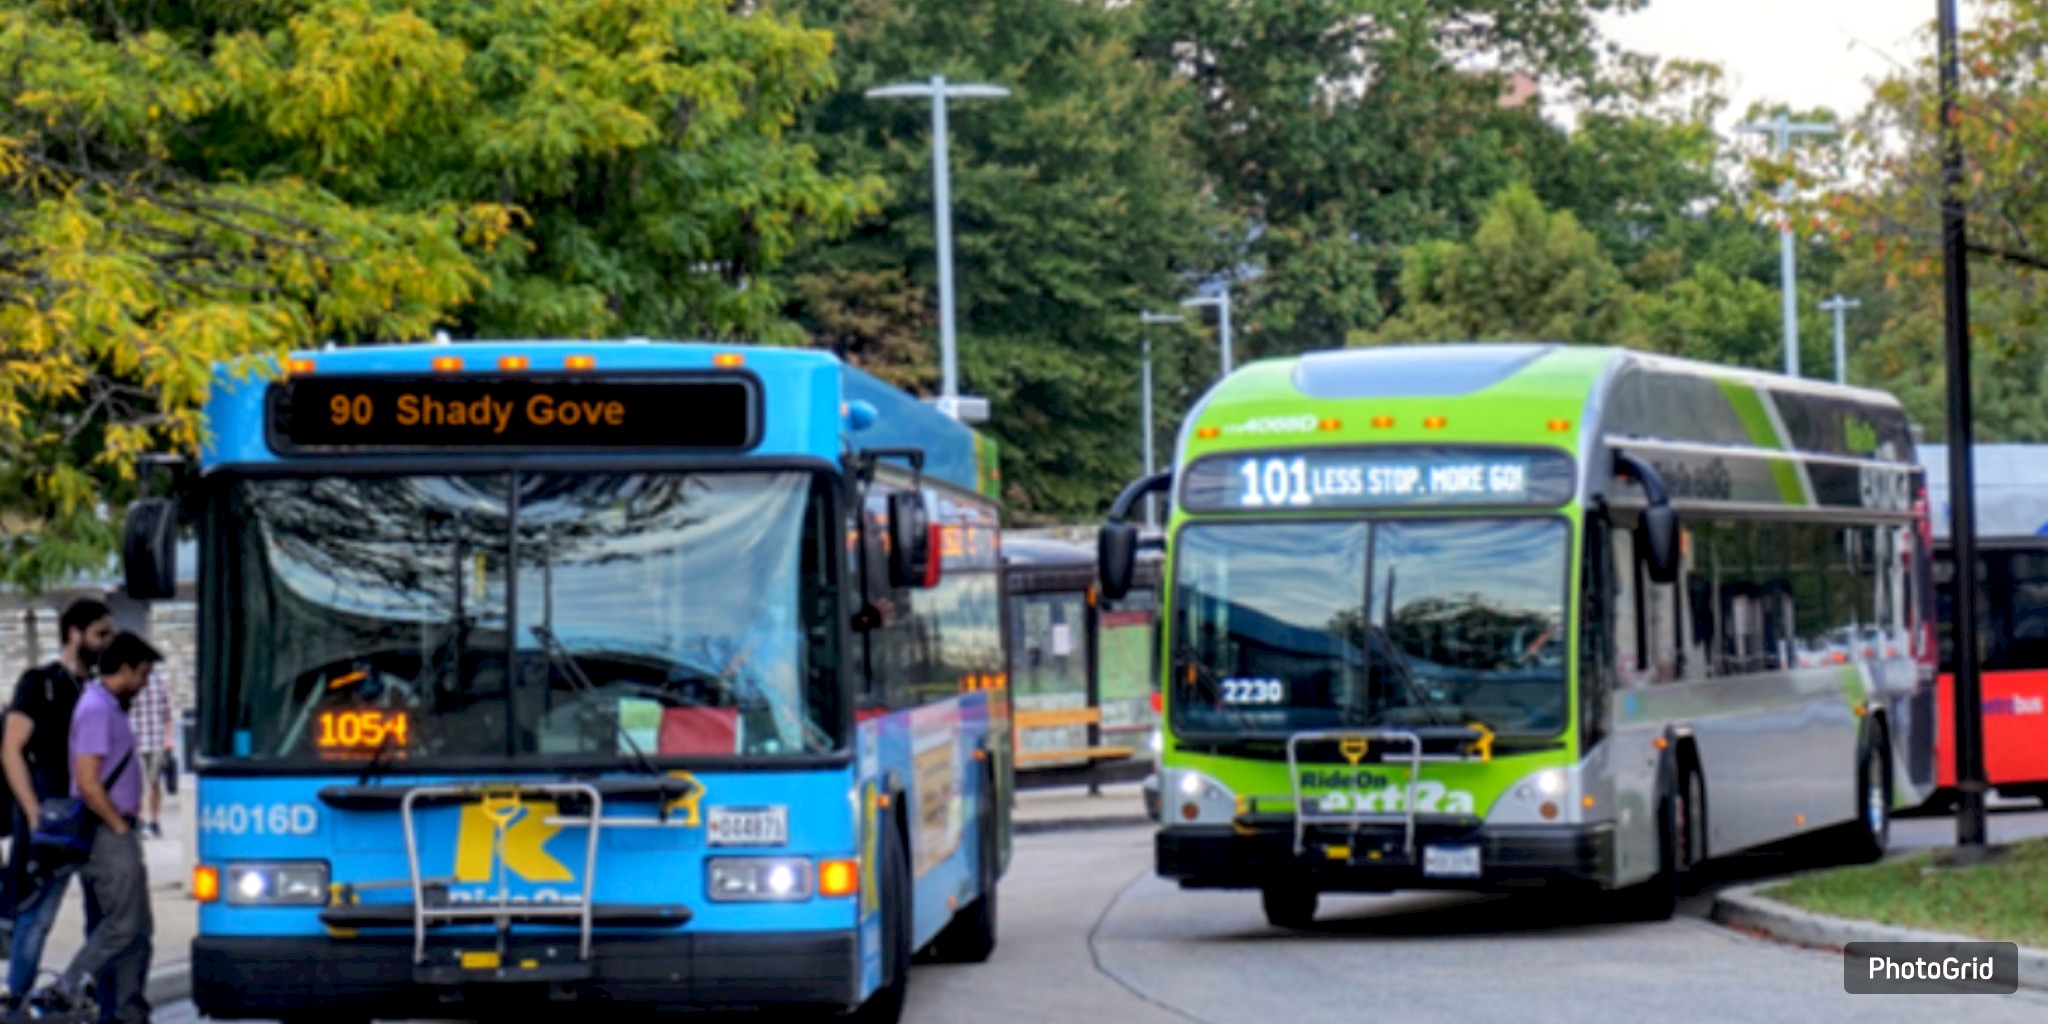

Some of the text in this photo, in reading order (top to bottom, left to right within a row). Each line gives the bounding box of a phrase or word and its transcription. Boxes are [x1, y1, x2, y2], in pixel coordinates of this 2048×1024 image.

[330, 394, 625, 434] 90 Shady Gove
[1241, 458, 1312, 505] 101
[1313, 467, 1362, 494] LESS
[1431, 465, 1485, 492] MORE
[1222, 678, 1283, 704] 2230
[318, 711, 407, 747] 1054
